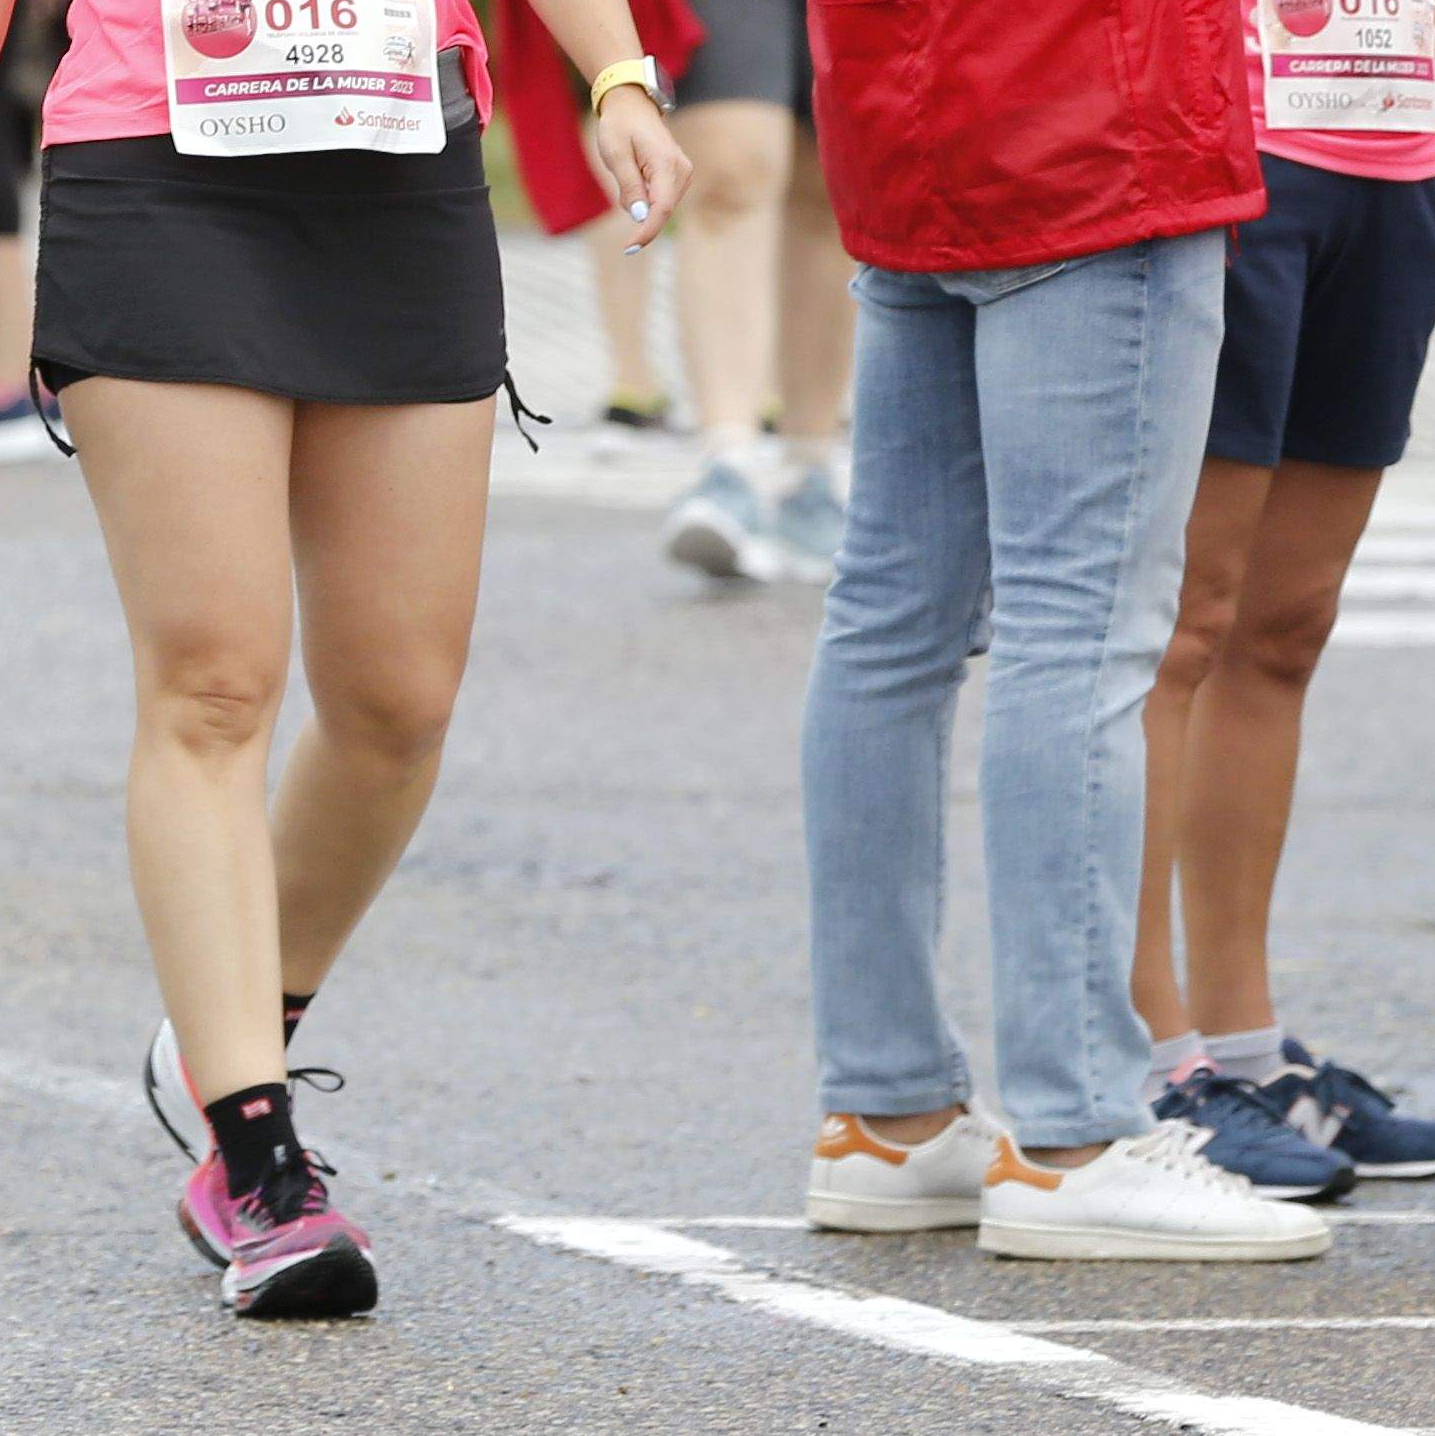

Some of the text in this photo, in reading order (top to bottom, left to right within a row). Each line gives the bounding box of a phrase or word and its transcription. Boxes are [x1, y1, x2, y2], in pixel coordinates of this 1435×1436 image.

[1356, 29, 1393, 49] 1052
[285, 43, 344, 65] 4928
[1289, 60, 1351, 74] CARRERA
[204, 77, 414, 97] CARRERA DE LA MUJER 2023
[1288, 92, 1352, 110] OYSHO
[200, 112, 422, 138] OYSHO Santander
